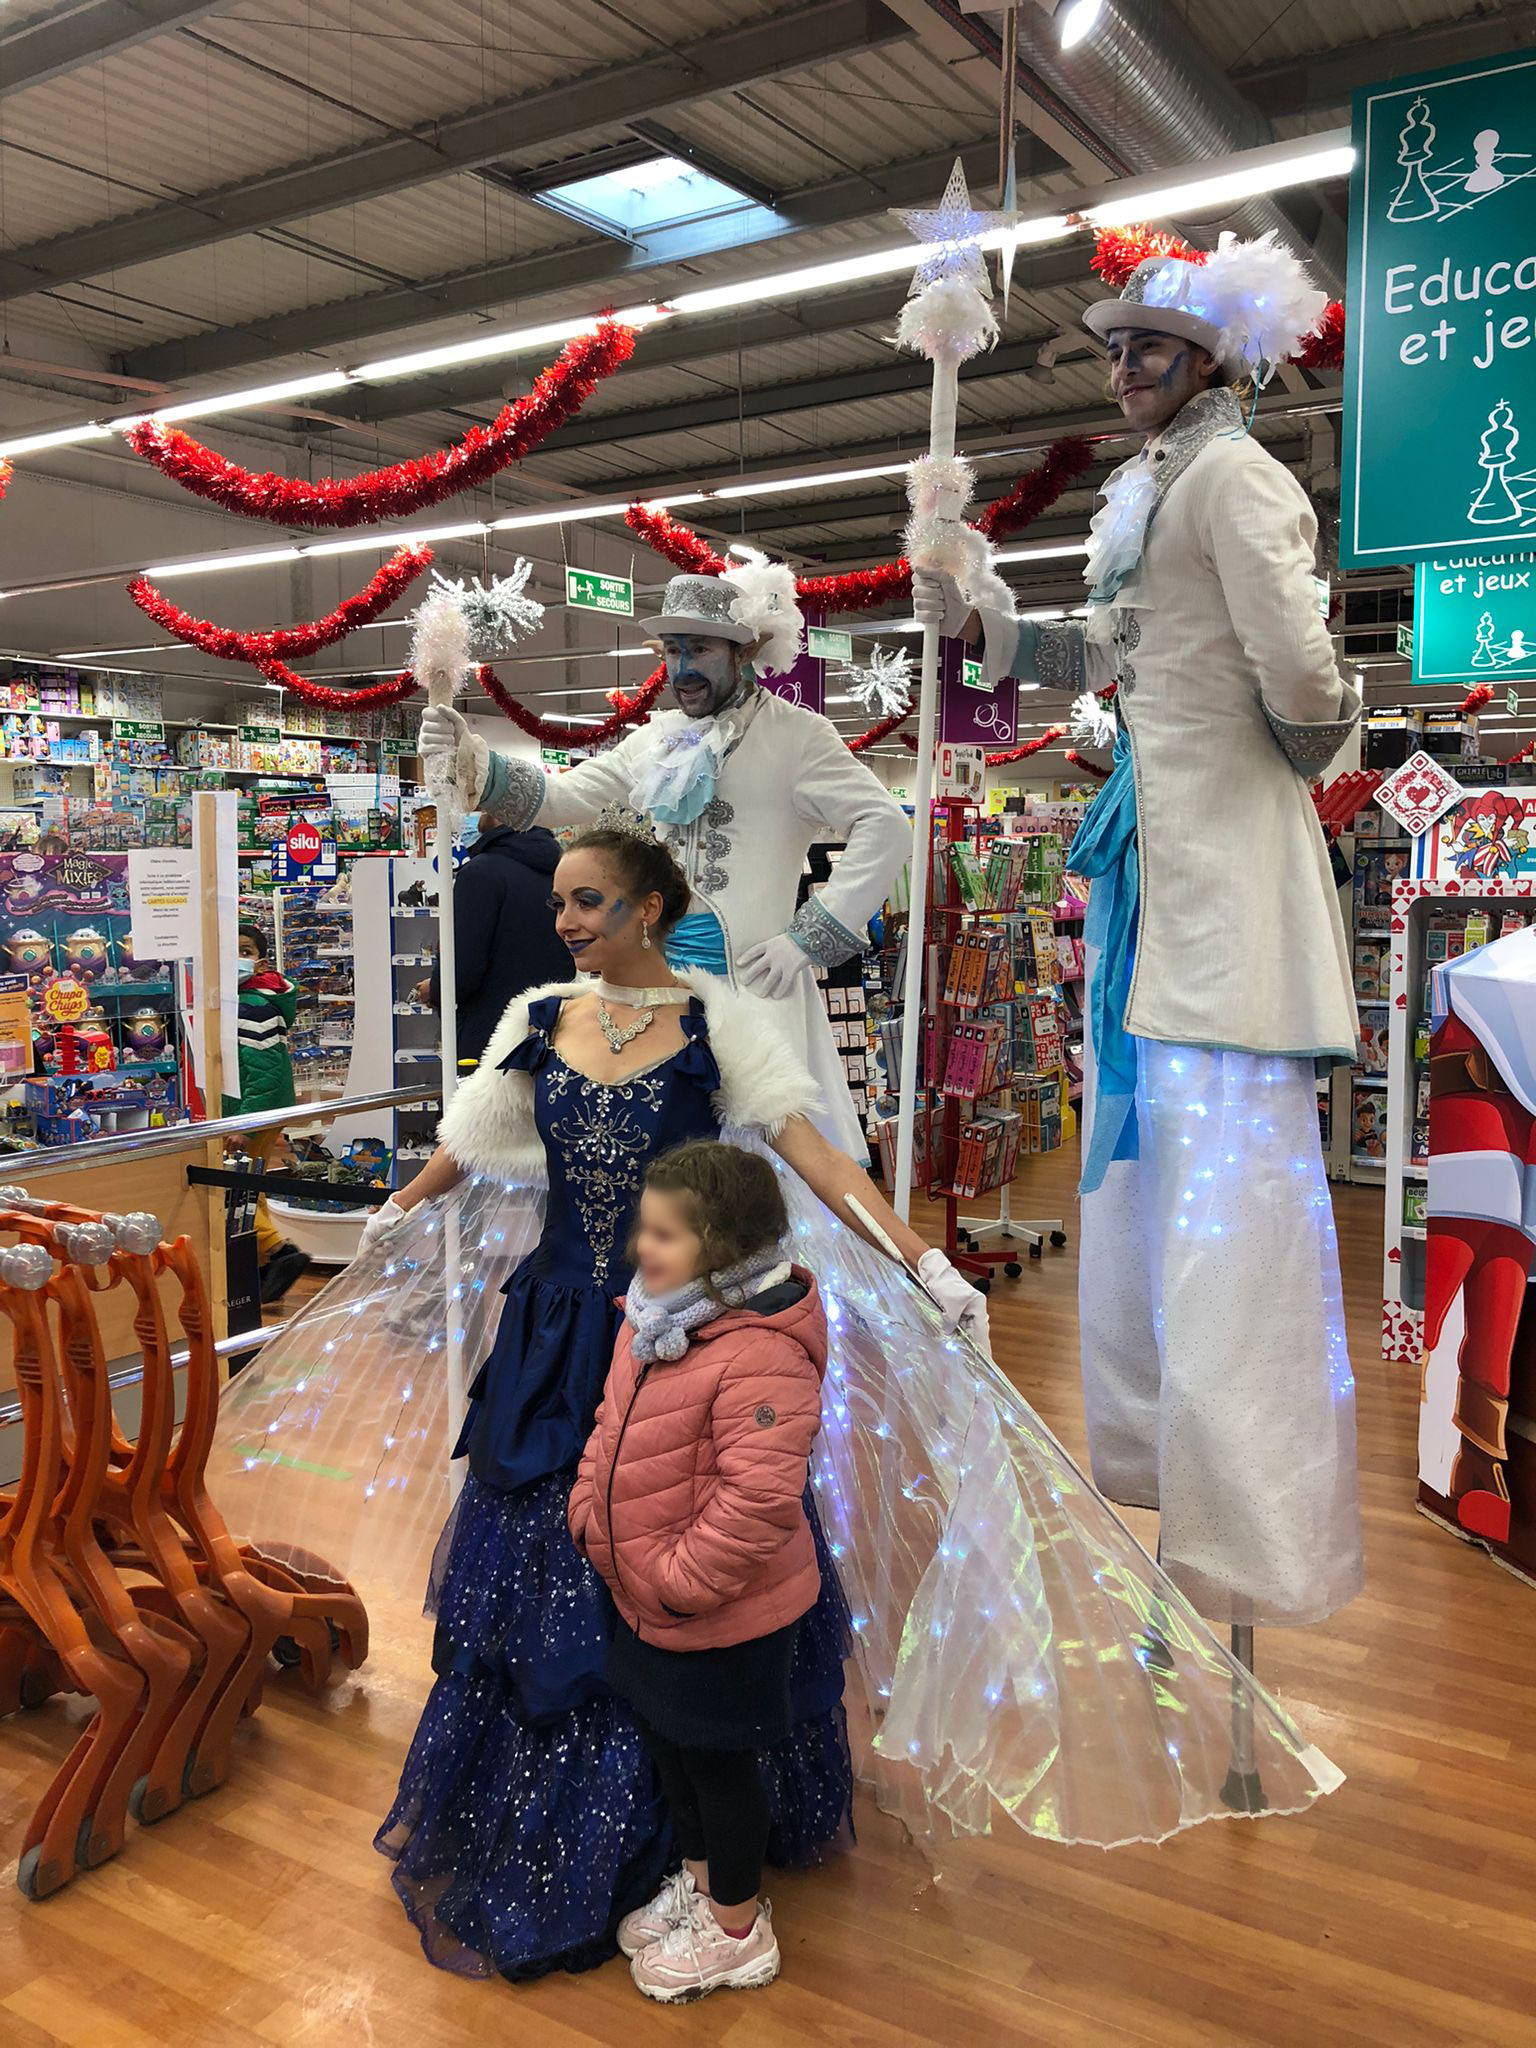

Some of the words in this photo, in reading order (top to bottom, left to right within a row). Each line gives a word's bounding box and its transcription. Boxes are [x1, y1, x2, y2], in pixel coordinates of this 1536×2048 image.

[1399, 319, 1457, 365] et
[1472, 308, 1536, 369] je
[599, 579, 626, 594] SORTIE
[1440, 574, 1467, 595] et
[1472, 571, 1531, 598] jeux
[596, 596, 630, 611] SECOURS
[289, 833, 320, 850] siku
[63, 858, 94, 870] Magic
[50, 990, 83, 1002] Chupa
[49, 1000, 82, 1012] Chups
